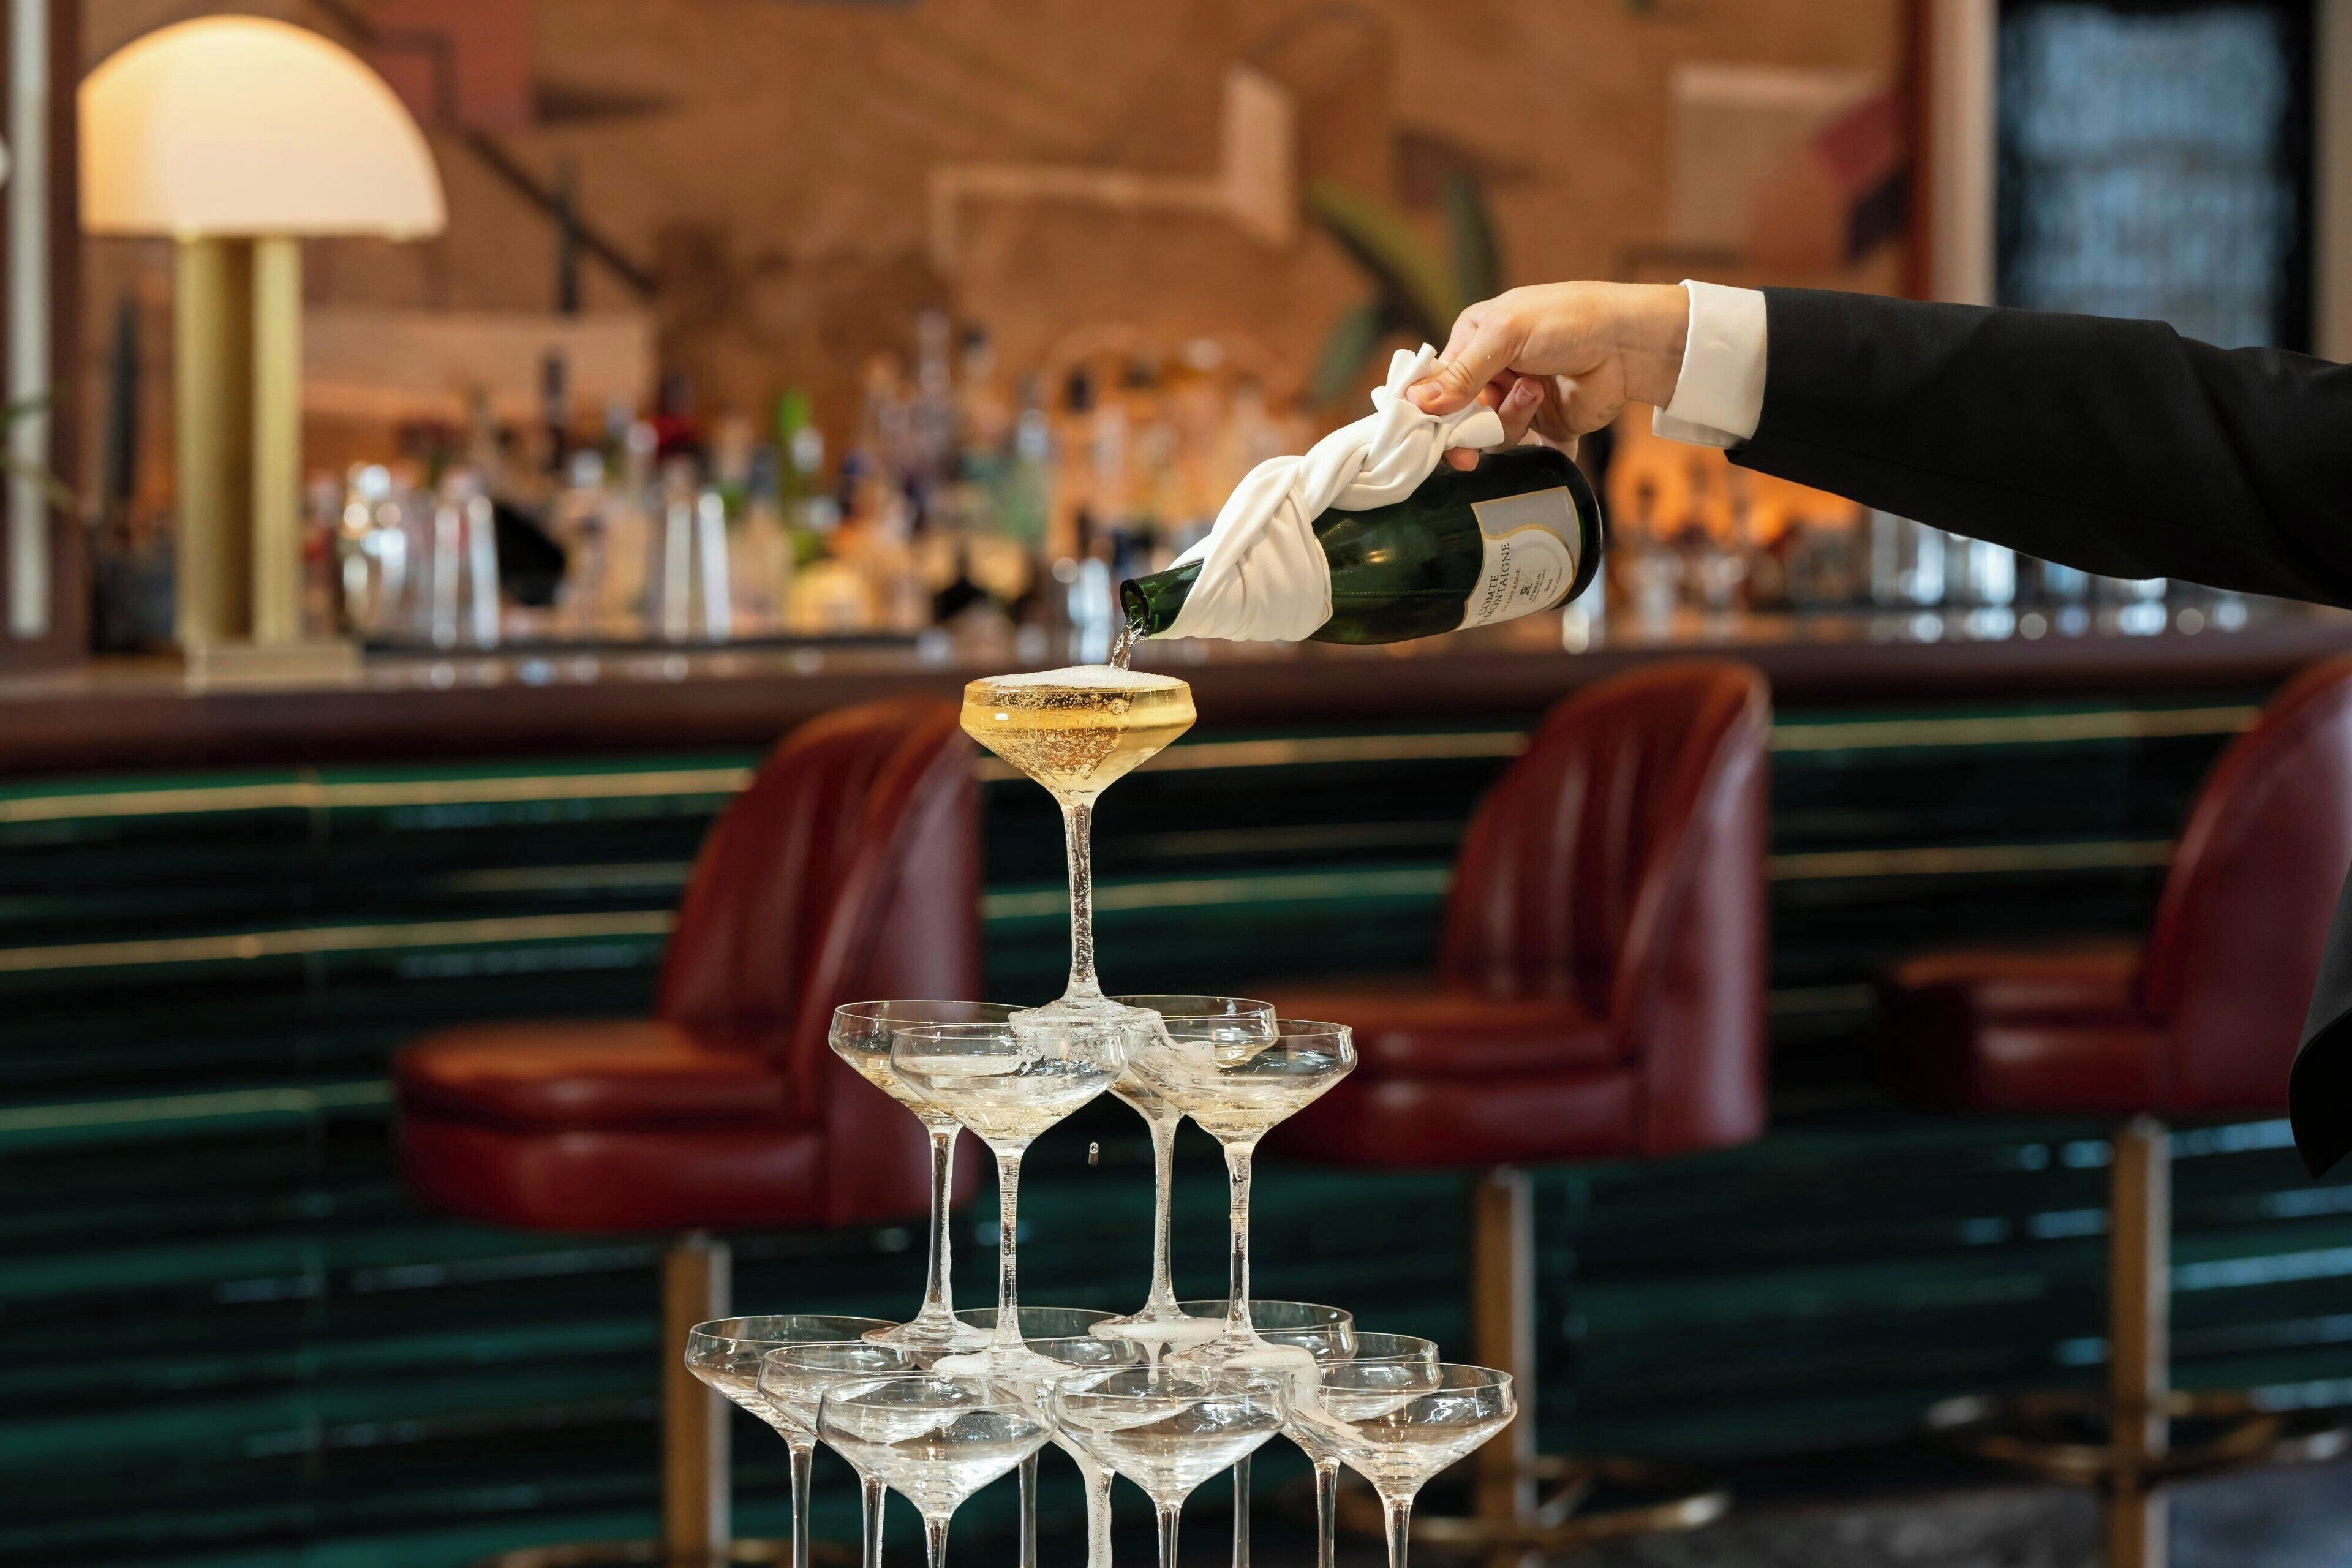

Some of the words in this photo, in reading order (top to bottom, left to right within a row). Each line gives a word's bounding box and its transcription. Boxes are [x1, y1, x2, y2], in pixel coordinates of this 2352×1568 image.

[1478, 575, 1499, 616] COMTE
[1485, 543, 1510, 618] MONTAIGNE
[1501, 568, 1521, 612] CHAMPAGNE
